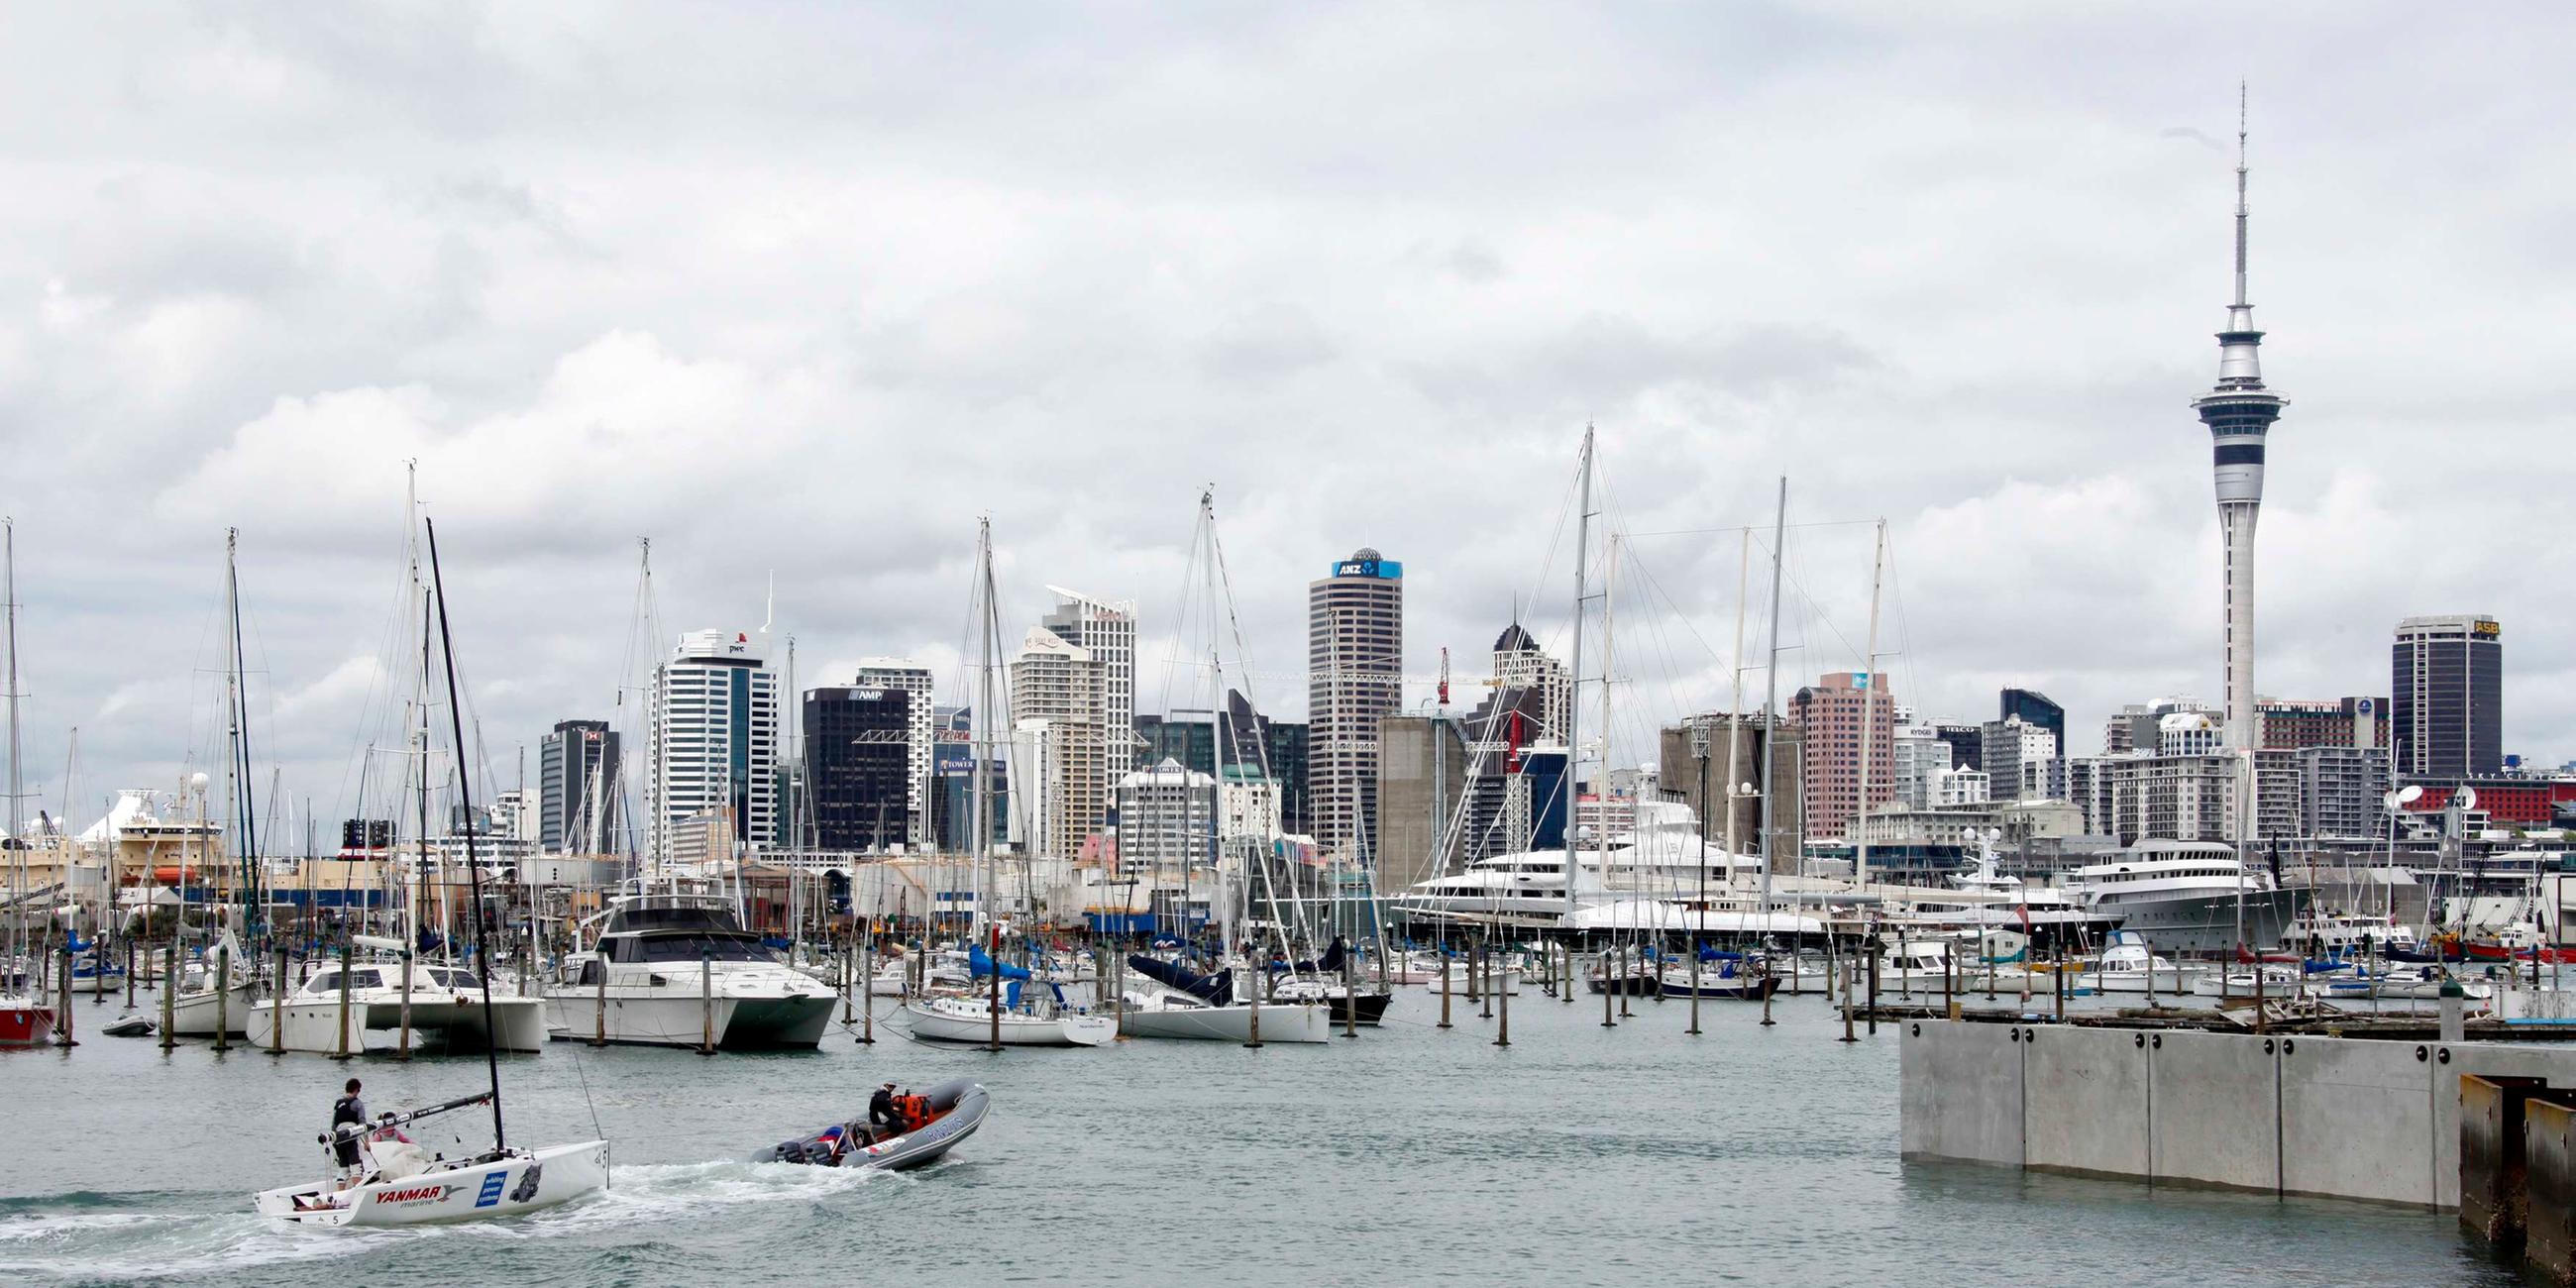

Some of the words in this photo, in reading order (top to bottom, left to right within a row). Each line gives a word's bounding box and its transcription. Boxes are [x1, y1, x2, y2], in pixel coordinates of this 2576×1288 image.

[1340, 565, 1361, 575] ANZ
[2476, 622, 2498, 634] ASB
[729, 645, 745, 654] pwc
[858, 691, 881, 699] AMP
[948, 760, 973, 769] TOWER
[376, 1185, 442, 1204] YANMAR
[400, 1198, 435, 1209] marine
[332, 1215, 339, 1225] 5
